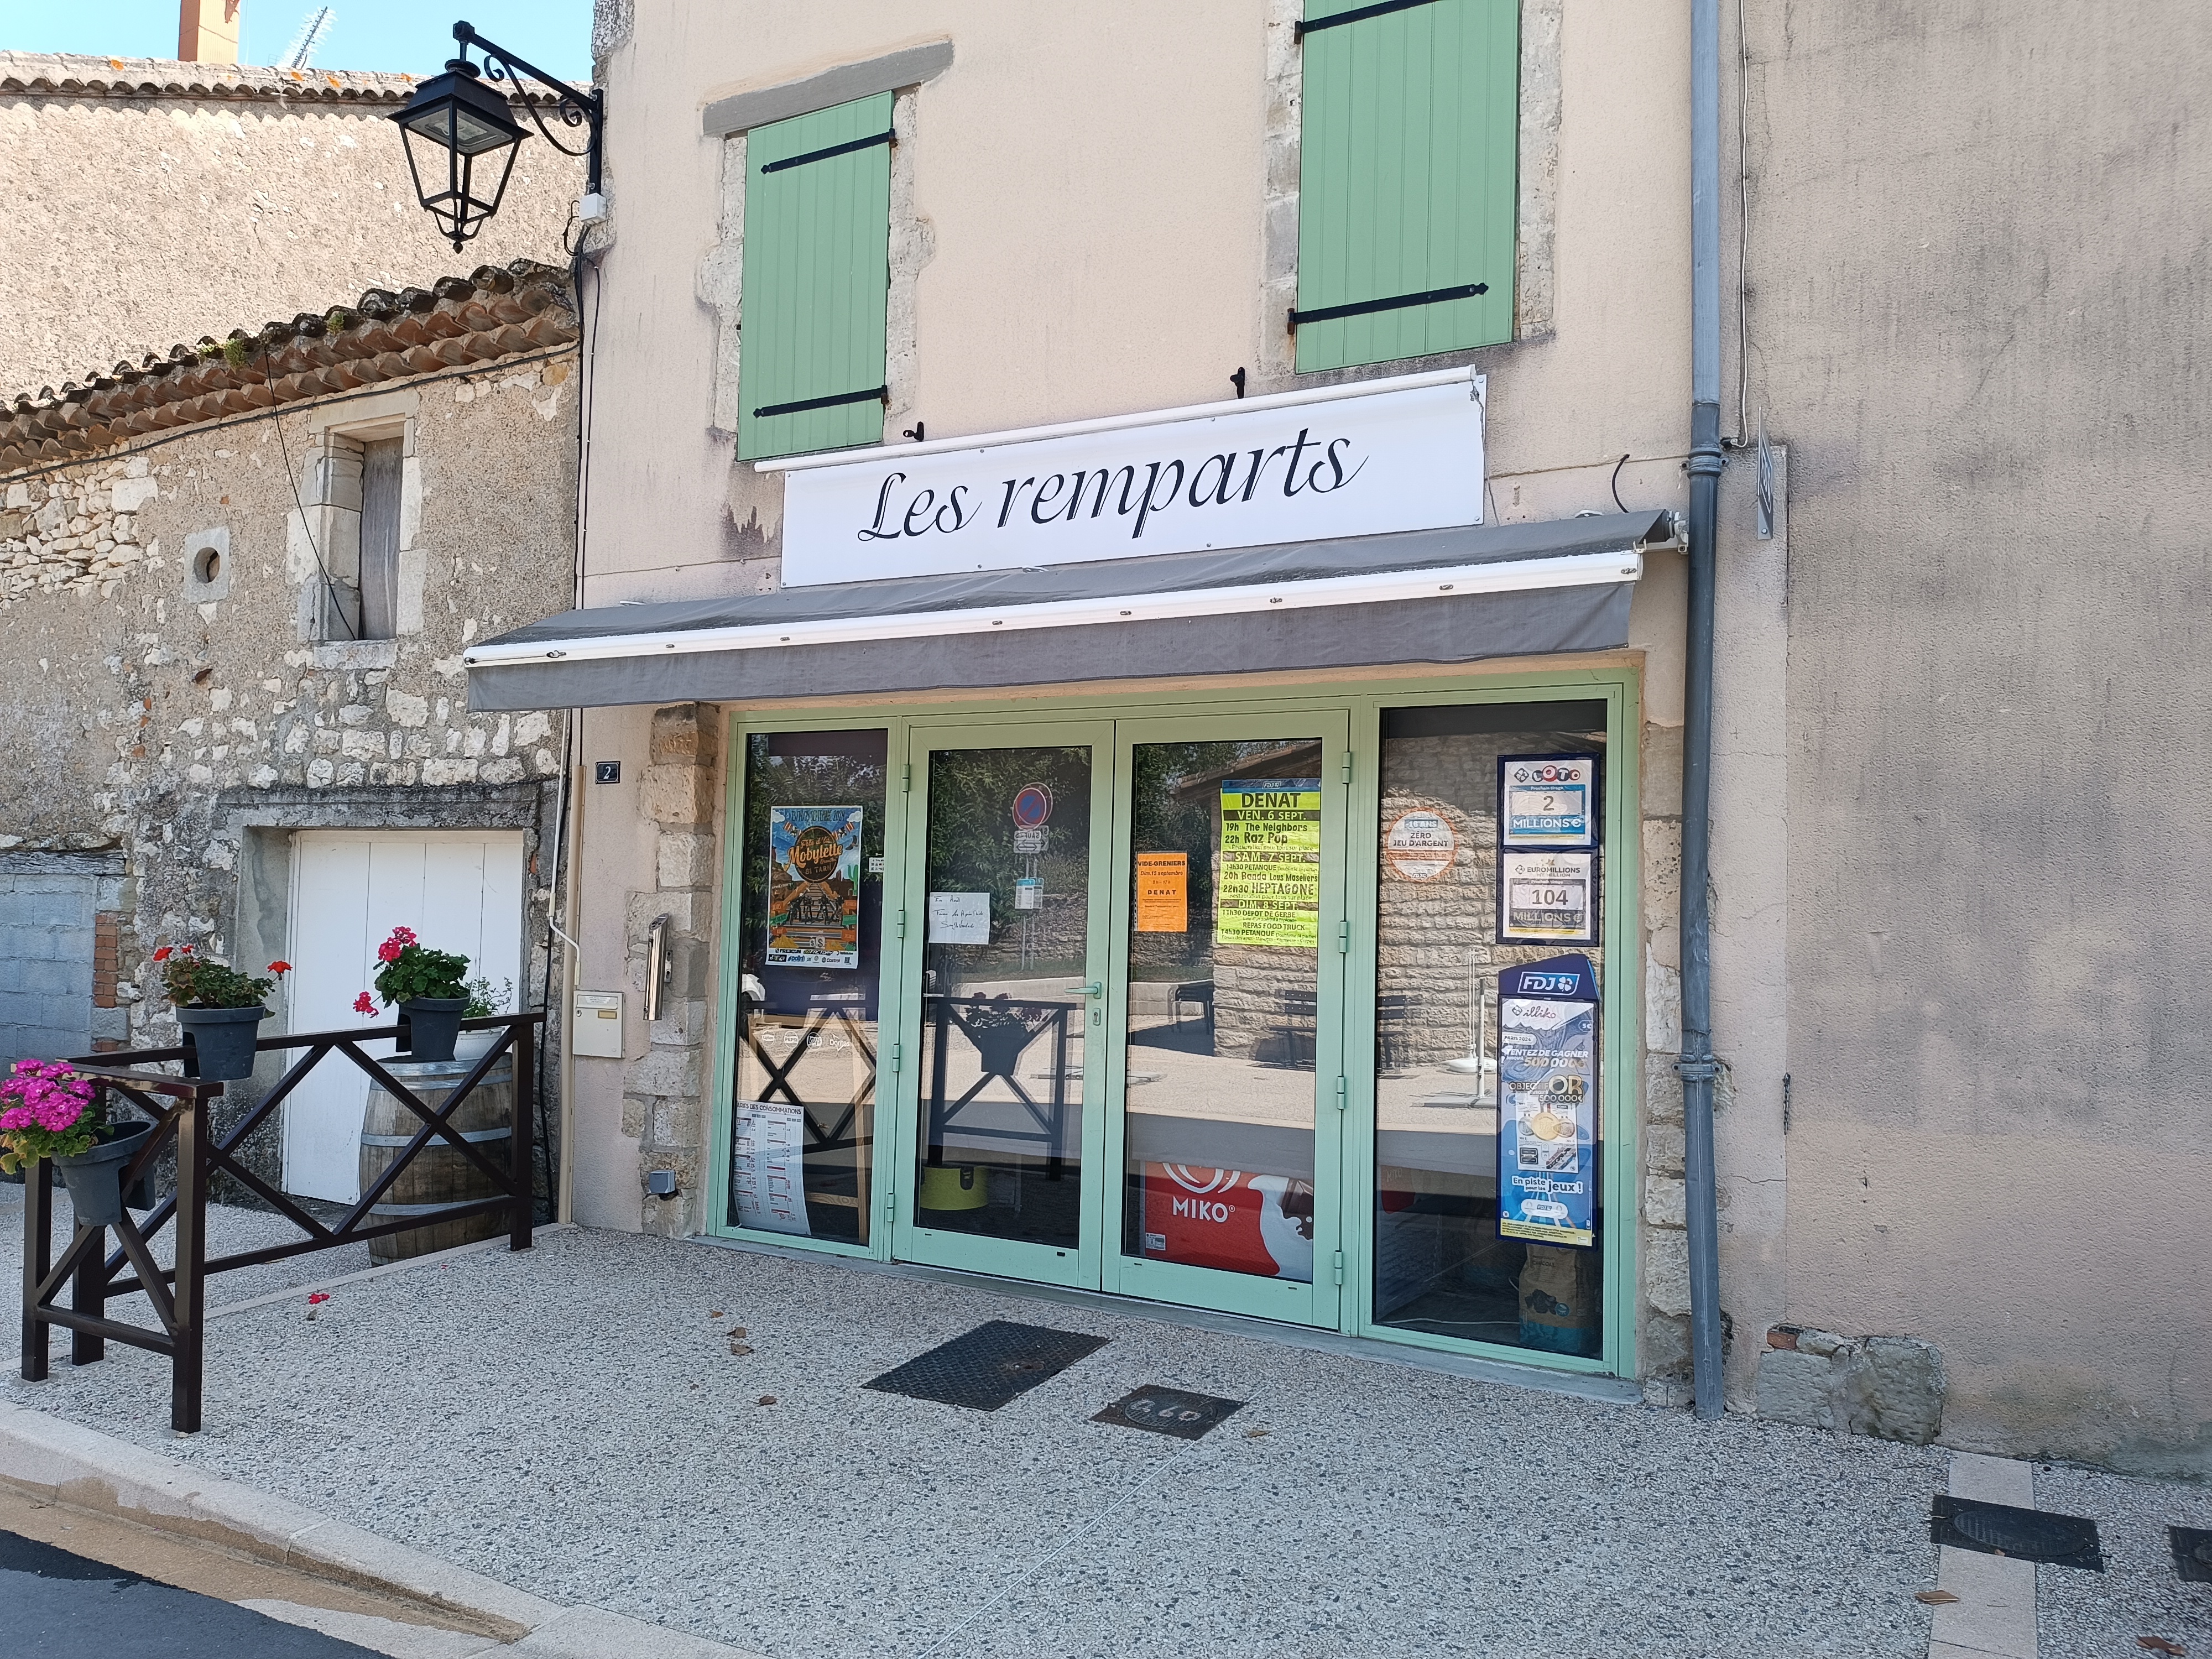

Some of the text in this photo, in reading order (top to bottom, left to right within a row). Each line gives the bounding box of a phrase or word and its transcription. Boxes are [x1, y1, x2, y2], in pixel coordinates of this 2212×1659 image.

[858, 428, 1369, 542] Les remparts
[603, 766, 611, 779] 2
[1532, 765, 1580, 782] LOTO
[1241, 793, 1301, 808] DENAT
[1543, 795, 1554, 811] 2
[1237, 810, 1306, 821] VEN. 6 SEPT.
[1225, 822, 1308, 833] 19h The Neighbors
[1513, 818, 1581, 828] MILLIONS €
[1225, 832, 1288, 846] 22h Raz Pop
[1410, 831, 1432, 839] ZÉRO
[787, 843, 842, 868] Mobylette
[1235, 852, 1306, 863] SAM. 7 SEPT.
[1223, 872, 1238, 880] 20h
[1241, 872, 1266, 880] Banda
[1223, 882, 1314, 895] 22h30 HEPTAGONE
[1532, 889, 1568, 905] 104
[1238, 900, 1299, 911] DIM. 8 SEPT.
[1513, 912, 1571, 922] MILLIONS
[1523, 976, 1556, 991] FDJ
[1522, 1005, 1556, 1019] illiko
[1548, 1074, 1583, 1094] OR
[759, 1105, 801, 1115] CONSOMMATIONS
[1547, 1181, 1575, 1193] jeux
[1173, 1196, 1228, 1223] MIKO
